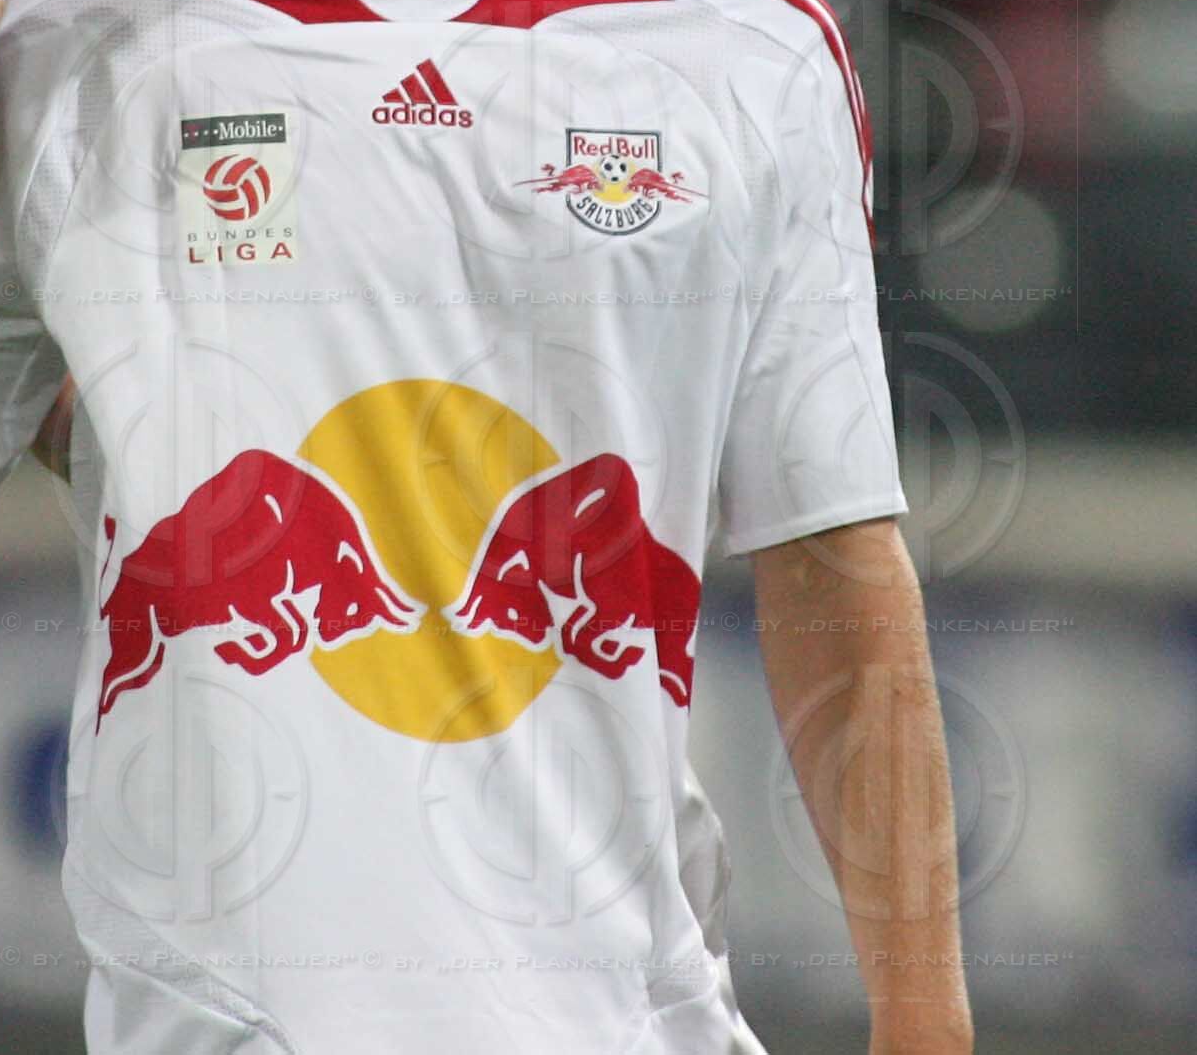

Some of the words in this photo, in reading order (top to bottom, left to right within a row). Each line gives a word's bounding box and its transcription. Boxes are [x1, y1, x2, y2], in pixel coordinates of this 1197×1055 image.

[372, 103, 473, 128] adidas
[573, 136, 612, 156] Red
[617, 138, 654, 159] Bull
[576, 195, 653, 228] SALZBURG
[187, 227, 293, 242] BUNDES
[188, 242, 292, 264] LIGA
